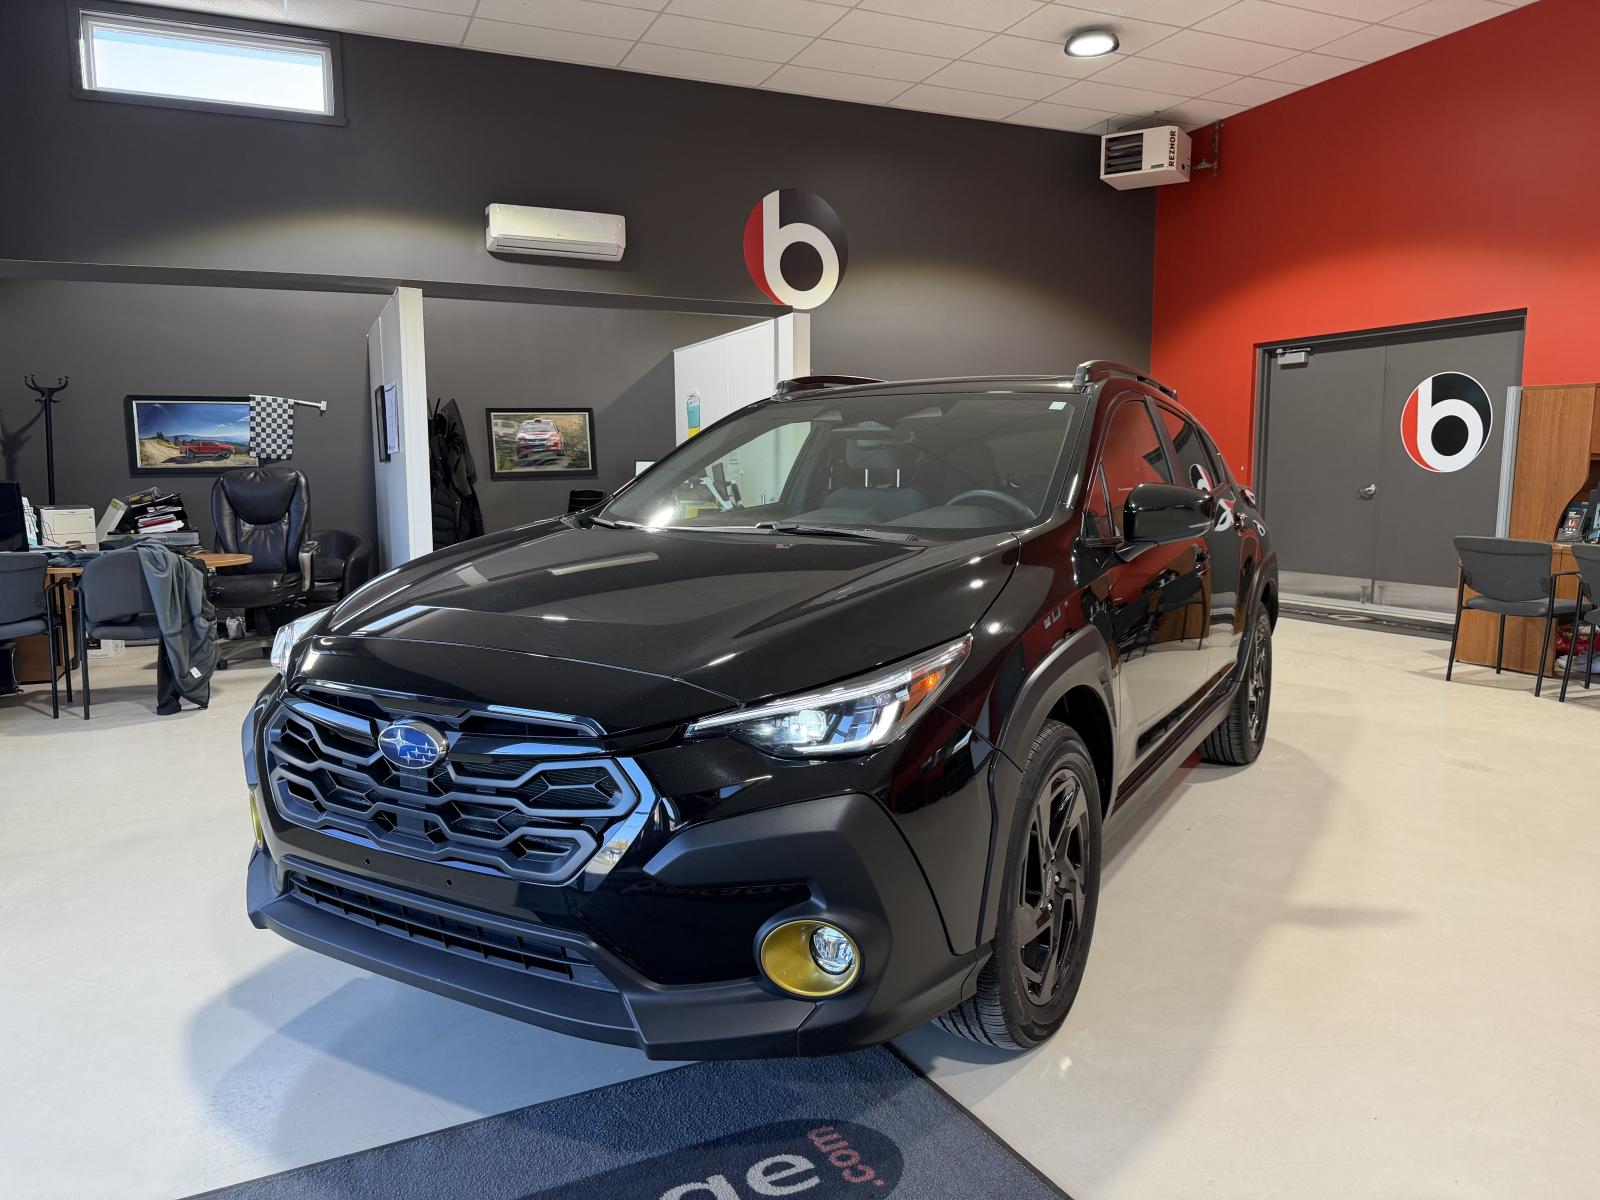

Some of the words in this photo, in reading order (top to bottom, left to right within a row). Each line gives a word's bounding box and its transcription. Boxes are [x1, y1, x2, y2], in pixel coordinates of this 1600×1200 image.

[1168, 130, 1177, 167] REZNOR
[762, 188, 840, 310] b
[1416, 374, 1484, 473] b
[807, 1125, 886, 1186] .com
